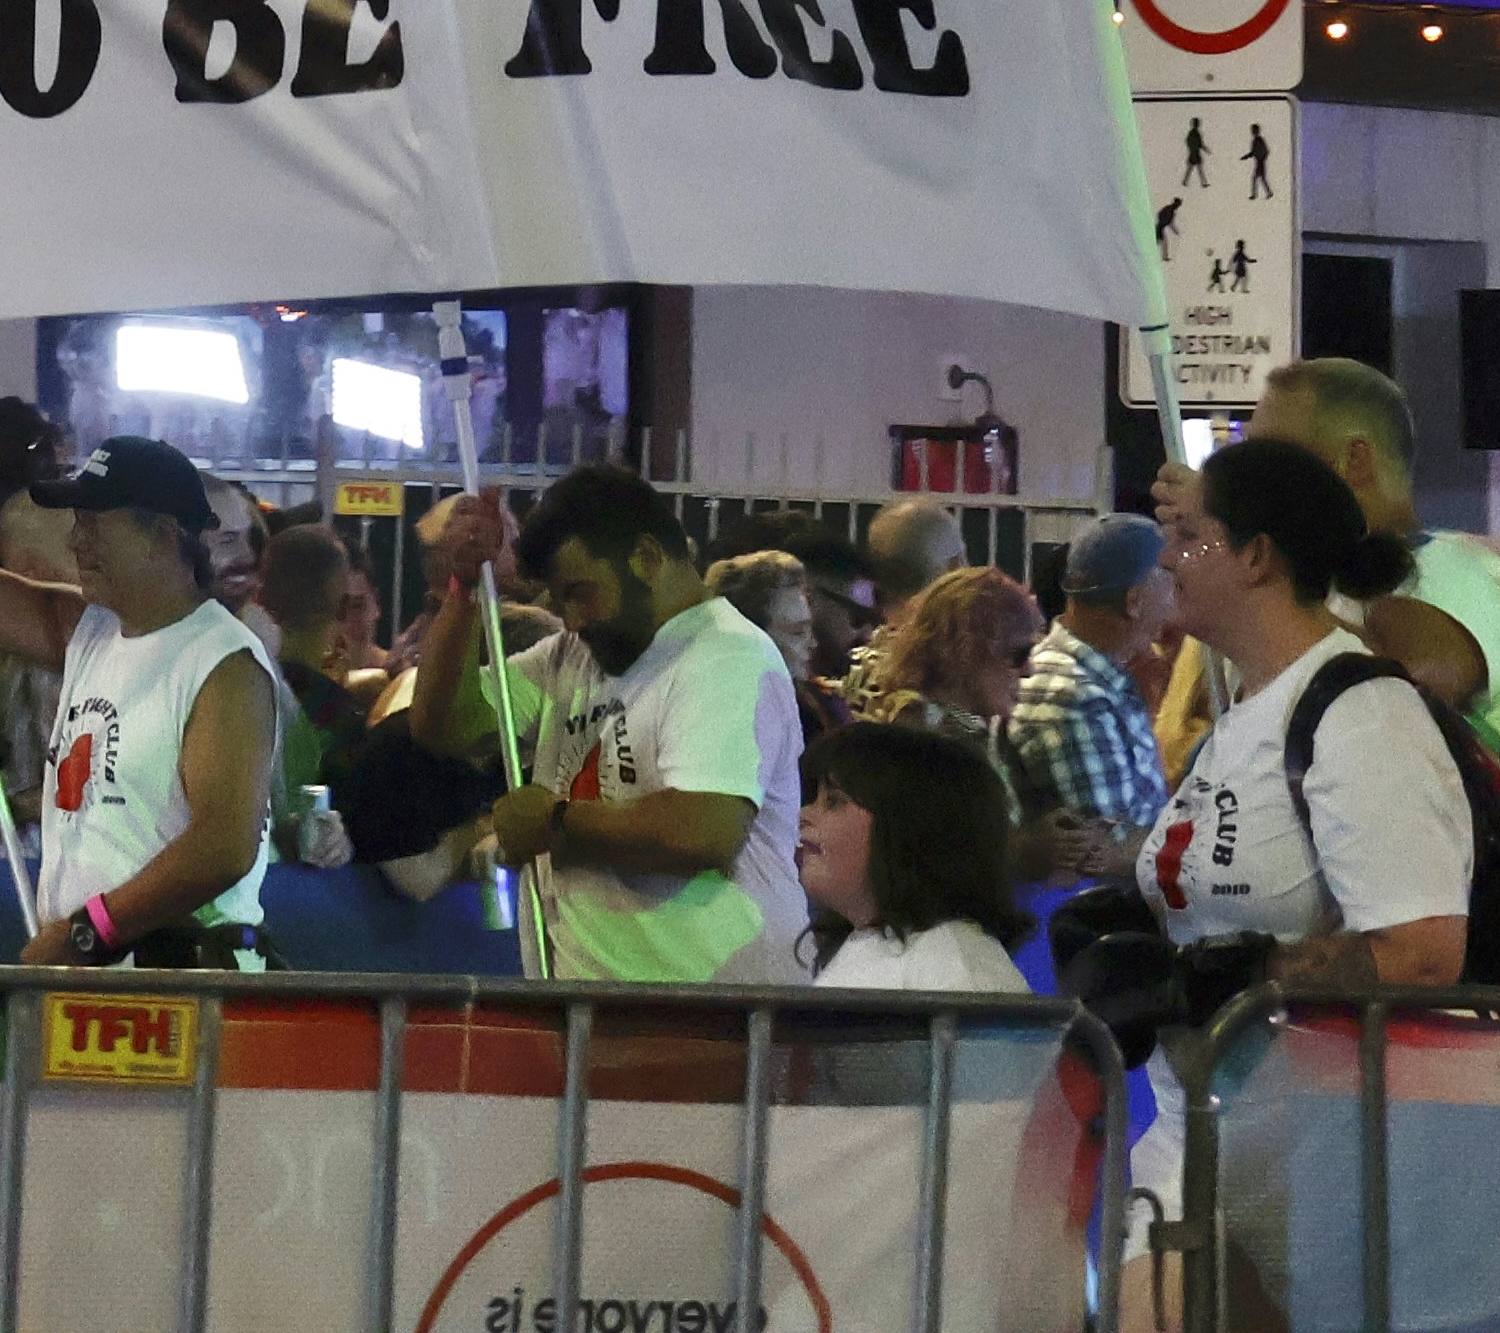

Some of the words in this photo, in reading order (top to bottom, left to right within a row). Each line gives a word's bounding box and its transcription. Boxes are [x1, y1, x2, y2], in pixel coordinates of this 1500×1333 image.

[1184, 306, 1233, 326] HIGH
[1170, 335, 1272, 355] DESTRIAN
[1212, 789, 1239, 867] CLUB
[64, 1004, 171, 1055] TFH
